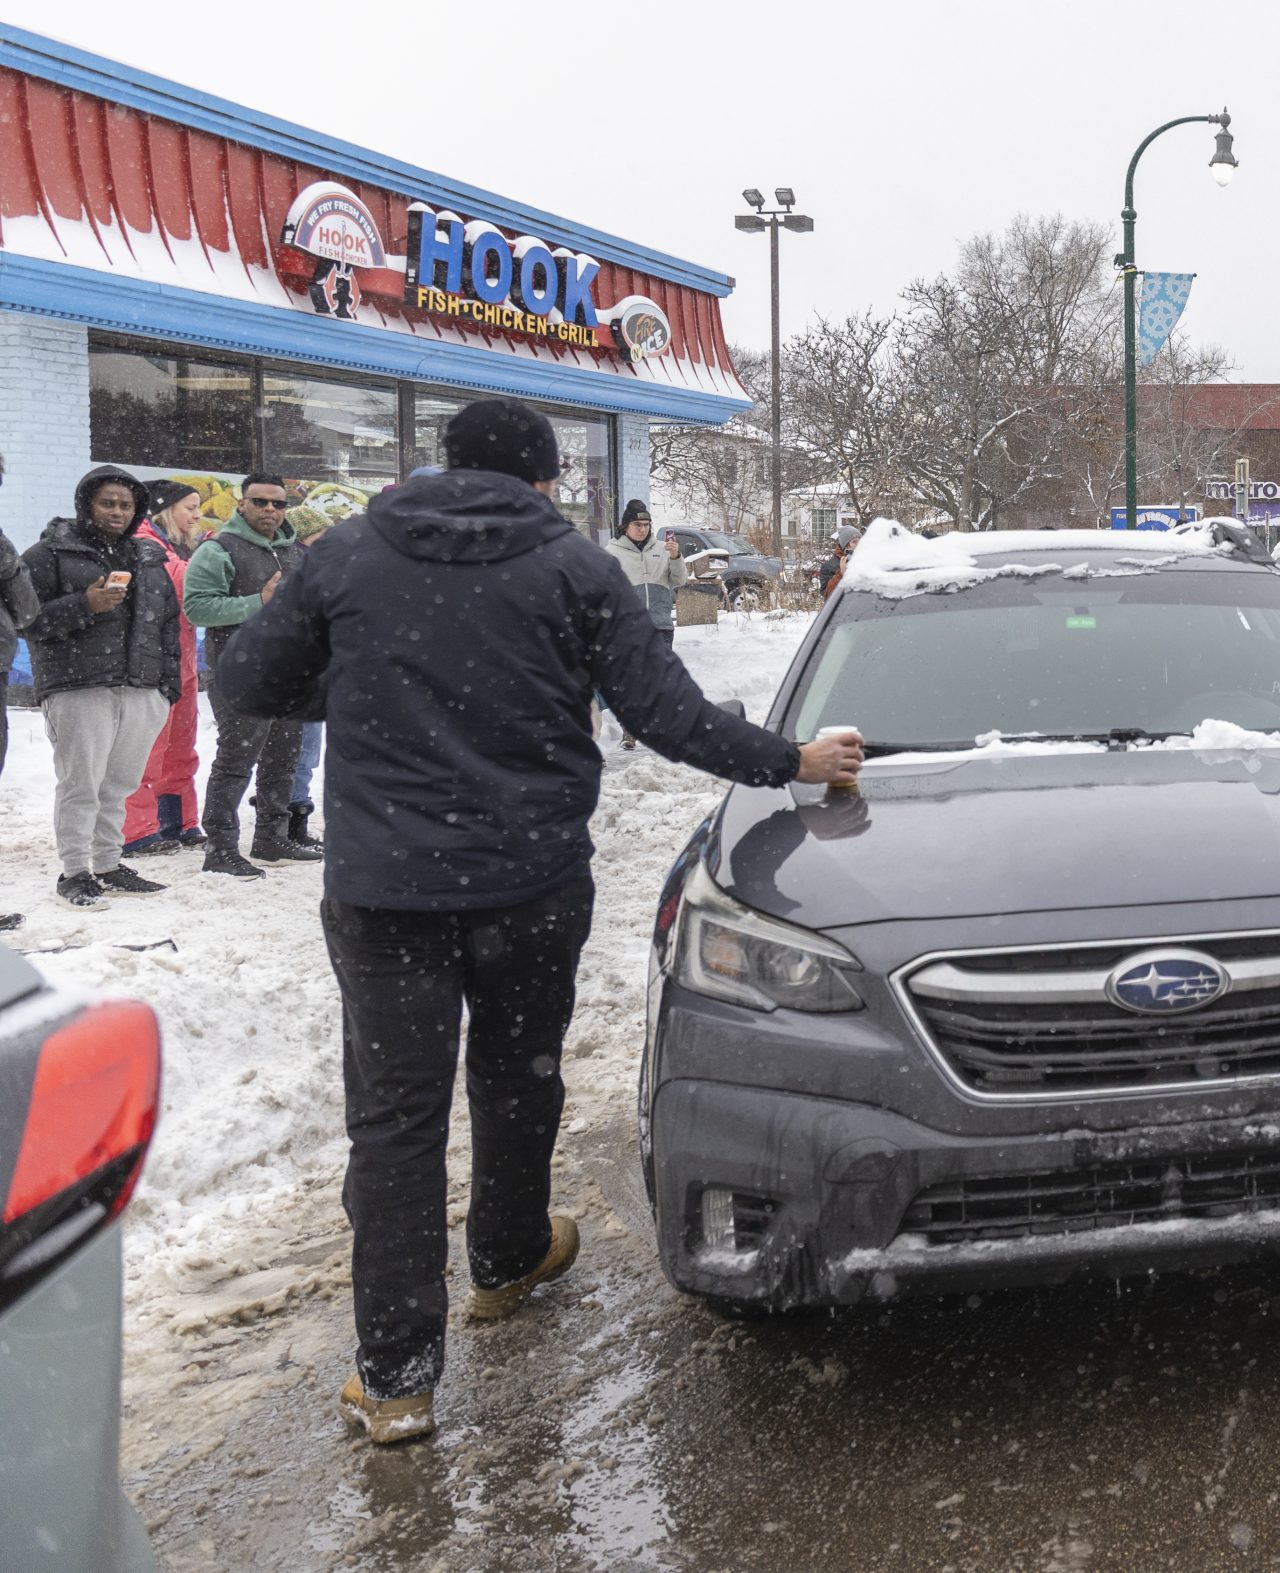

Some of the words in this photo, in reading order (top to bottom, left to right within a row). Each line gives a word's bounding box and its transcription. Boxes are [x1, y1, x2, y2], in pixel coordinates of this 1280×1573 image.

[307, 208, 320, 227] WE
[318, 200, 333, 215] FRY
[334, 200, 360, 219] FRESH
[359, 216, 377, 244] FISH
[319, 226, 366, 254] HOOK
[319, 246, 340, 257] FISH
[418, 210, 600, 328] HOOK
[417, 287, 460, 316] FISH
[472, 301, 547, 336] CHICKEN
[558, 322, 599, 347] GRILL
[641, 328, 663, 356] ICE
